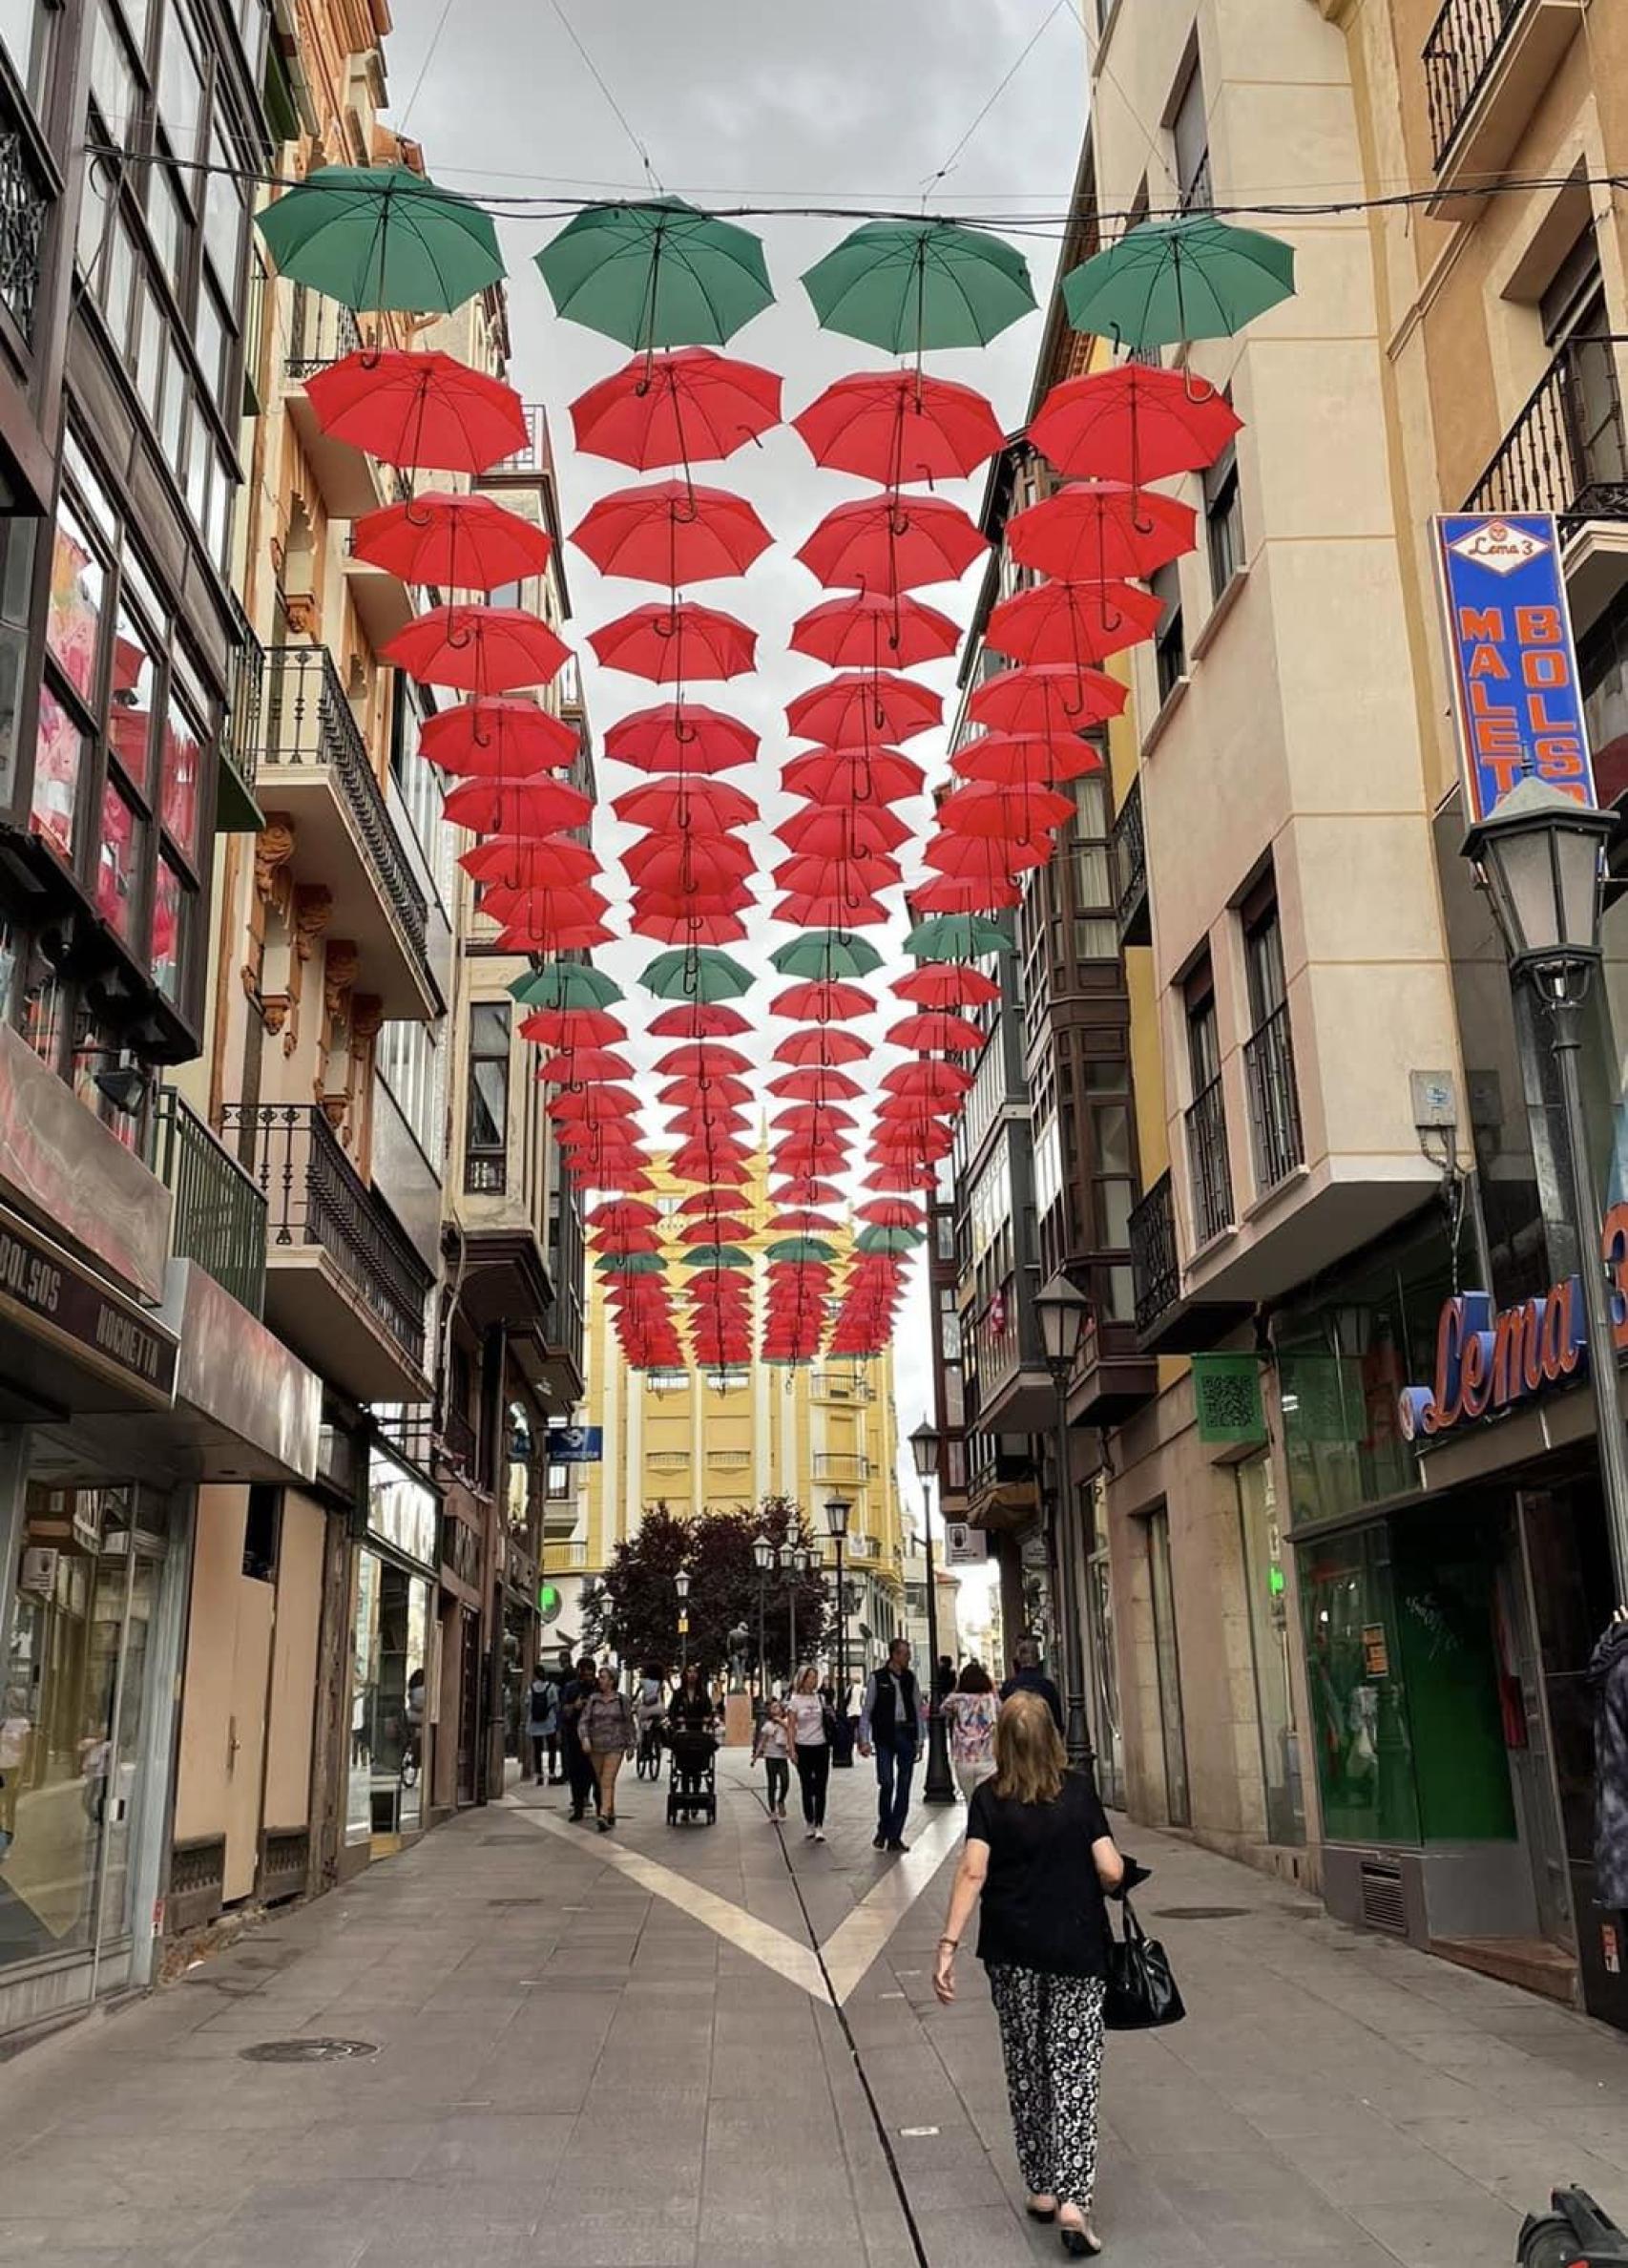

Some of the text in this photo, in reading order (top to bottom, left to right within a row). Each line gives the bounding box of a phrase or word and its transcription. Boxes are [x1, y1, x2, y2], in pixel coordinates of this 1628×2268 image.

[1468, 536, 1533, 556] Lema 3
[1459, 606, 1524, 808] MALET
[1421, 1279, 1582, 1435] Lema
